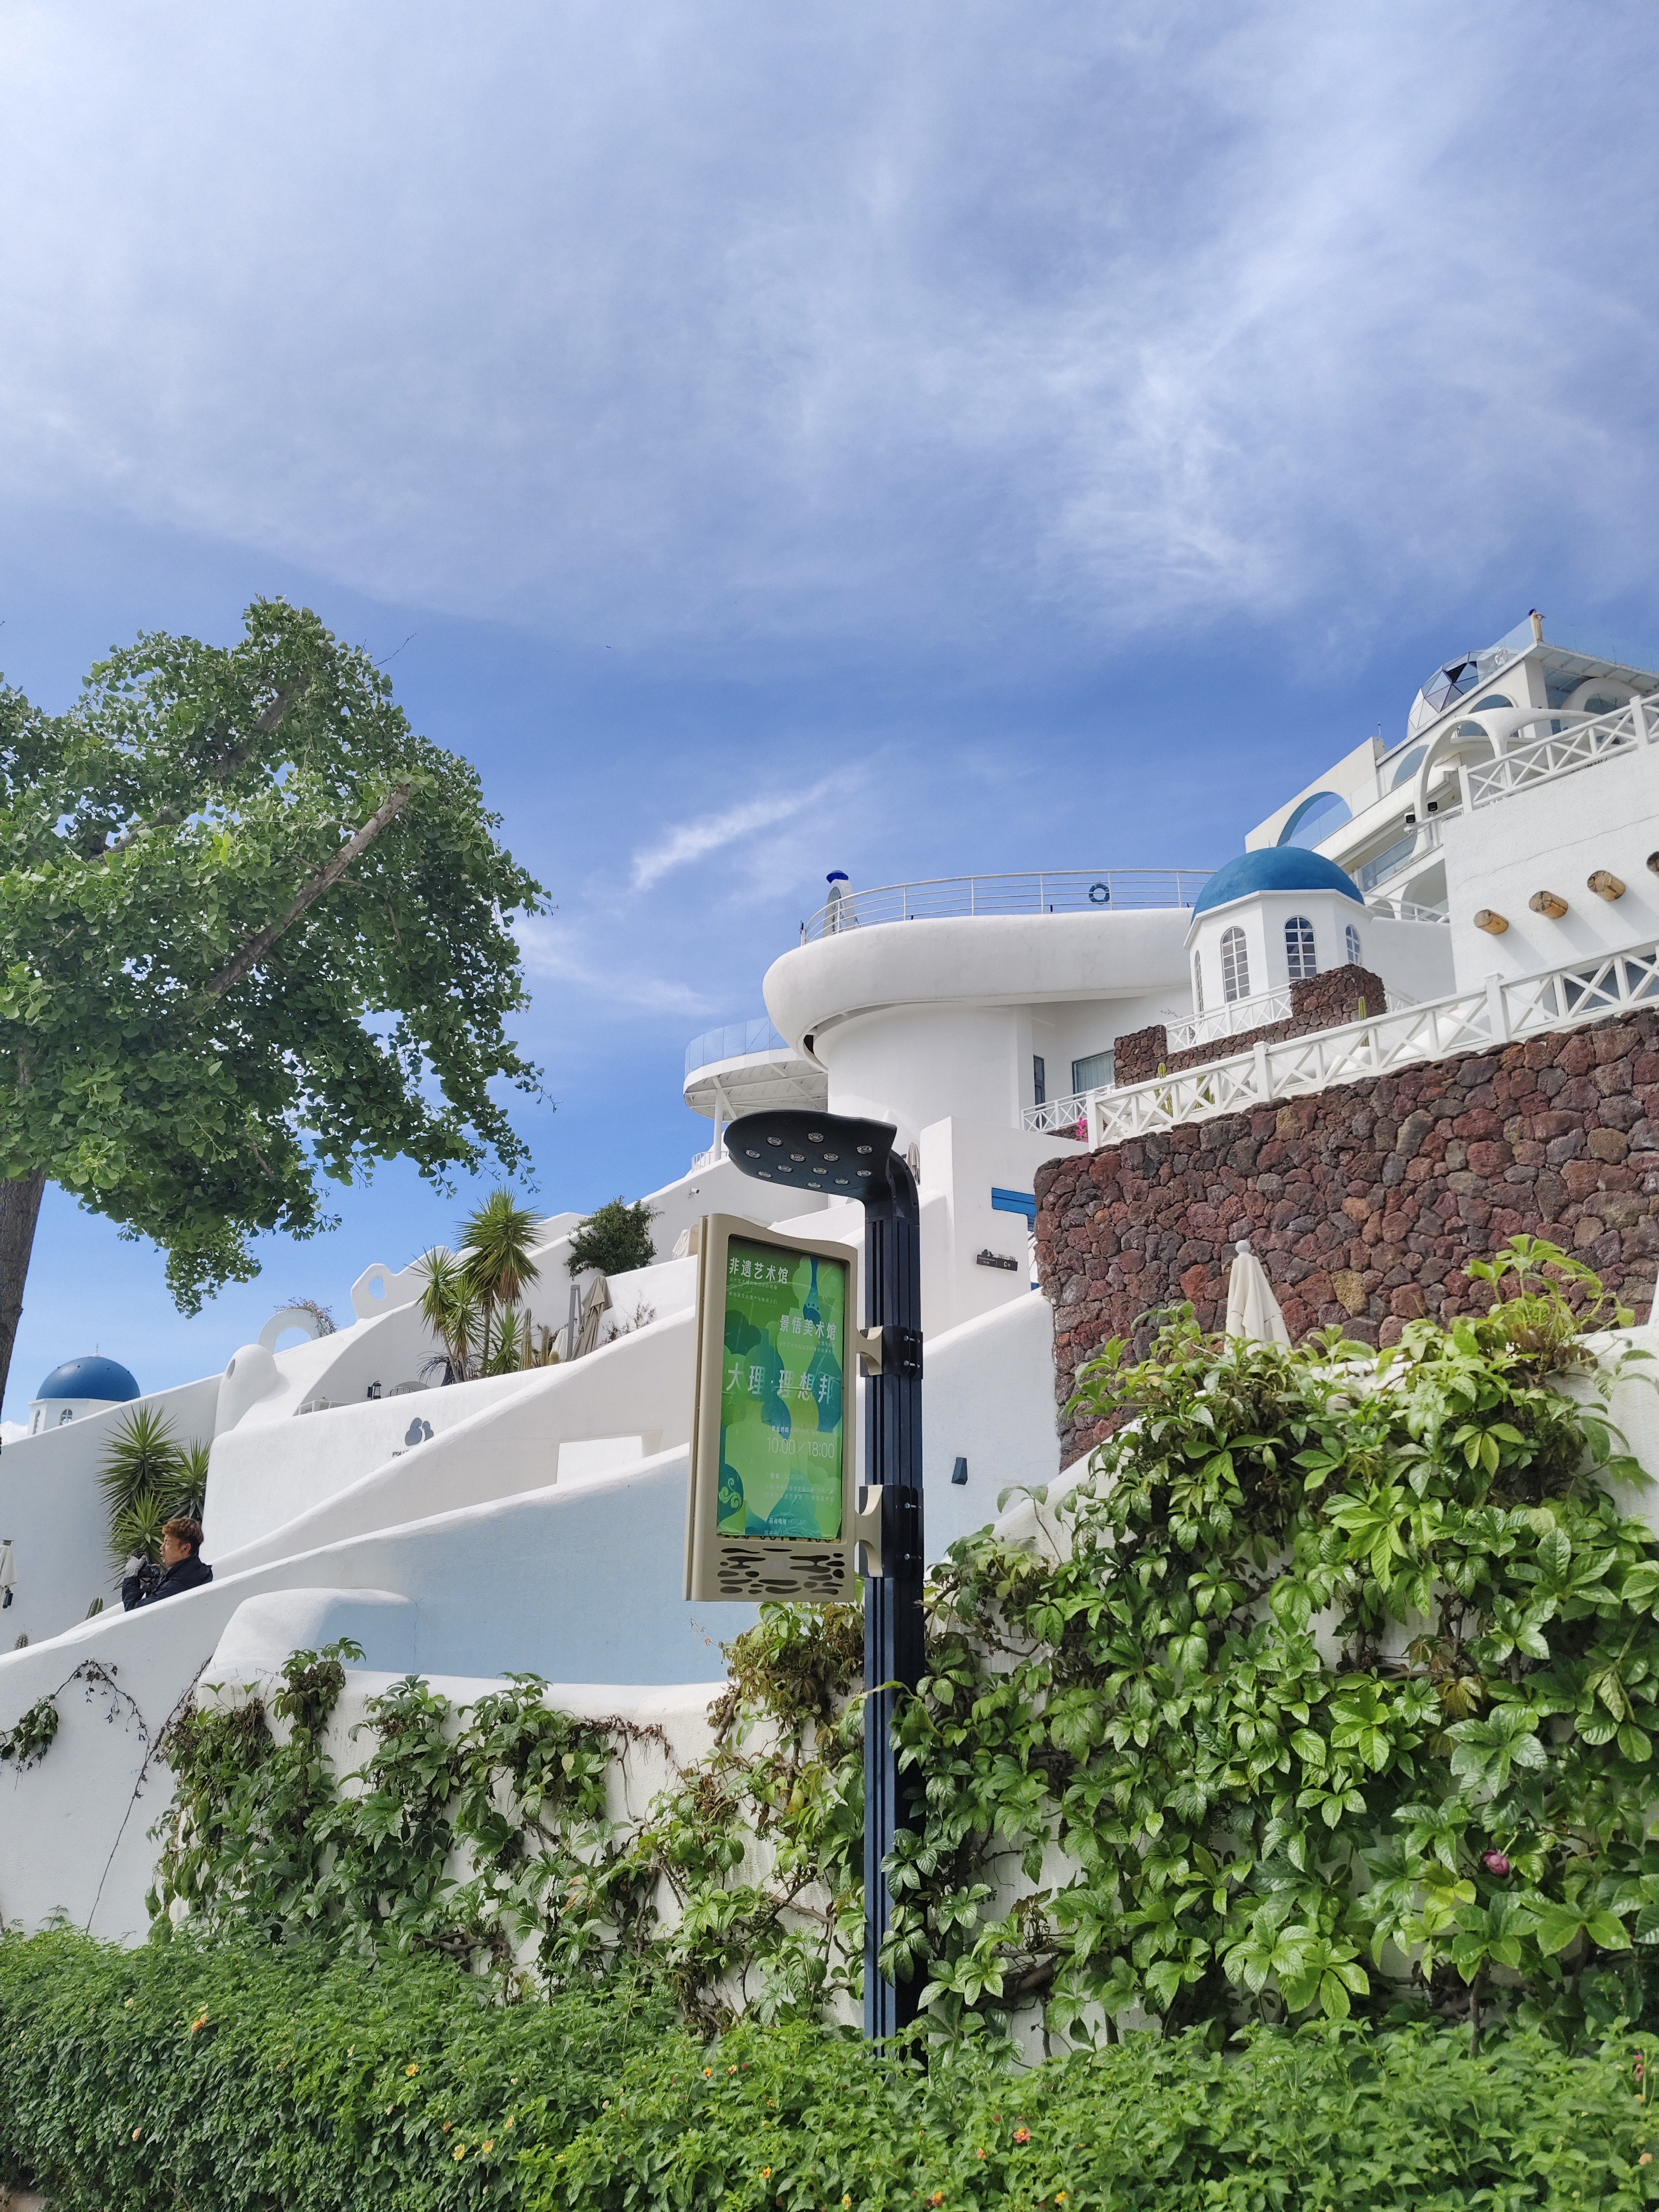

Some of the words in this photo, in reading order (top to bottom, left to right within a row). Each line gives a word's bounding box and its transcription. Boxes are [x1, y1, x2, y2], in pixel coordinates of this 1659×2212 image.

[729, 1257, 788, 1284] 非遗艺术馆
[779, 1314, 837, 1340] 景悟美术馆
